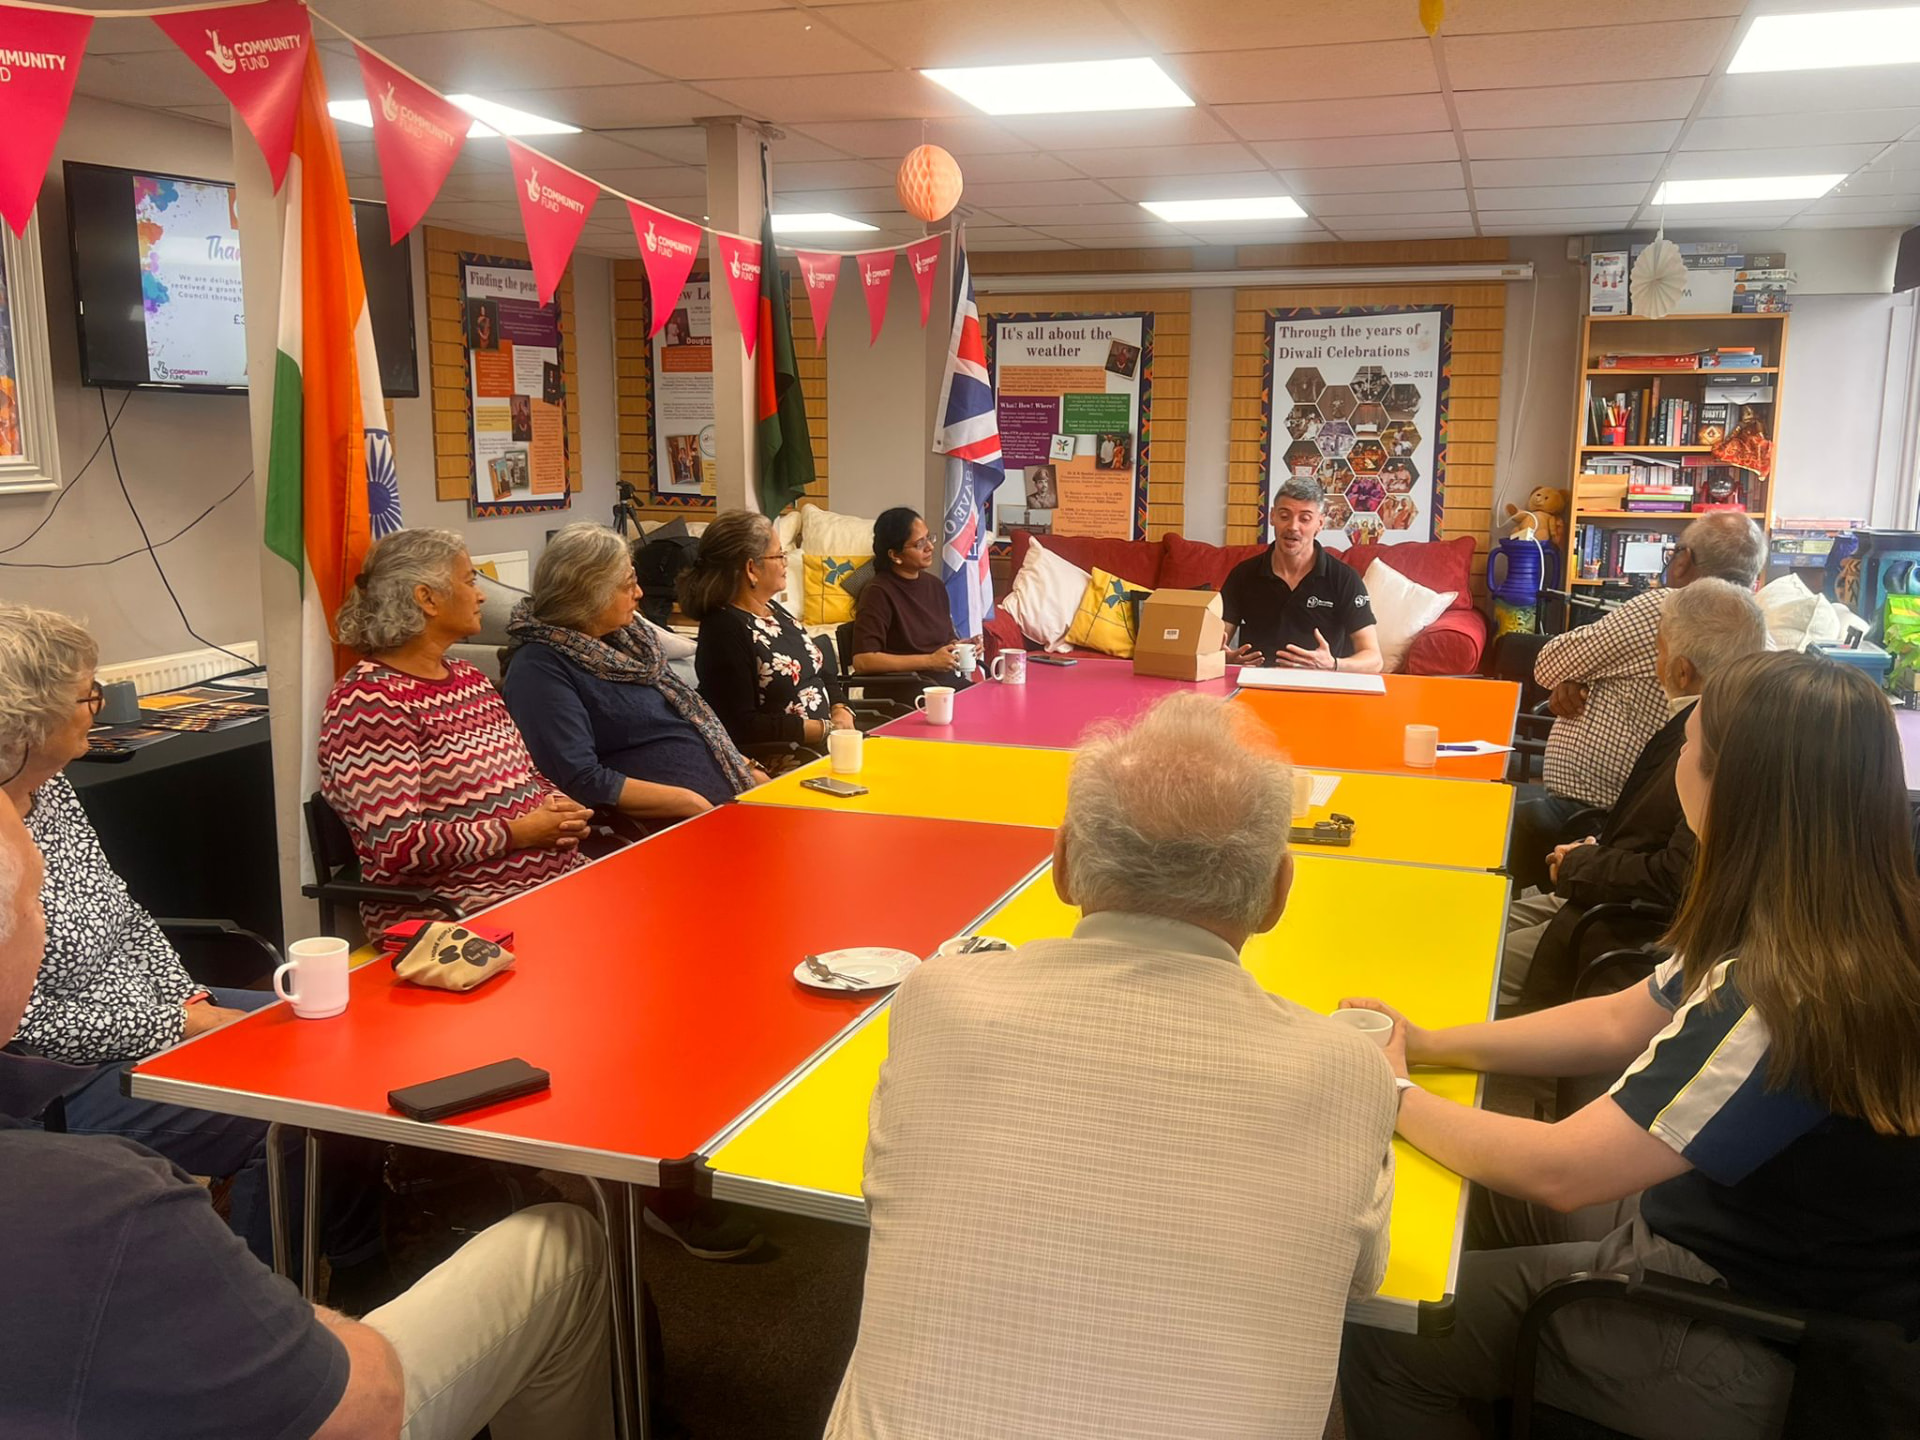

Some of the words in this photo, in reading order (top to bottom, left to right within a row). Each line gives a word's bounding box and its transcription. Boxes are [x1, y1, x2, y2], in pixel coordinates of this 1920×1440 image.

[234, 34, 300, 57] COMMUNITY
[240, 55, 270, 72] FUND
[401, 105, 455, 147] COMMUNITY
[540, 196, 560, 213] FUND
[541, 185, 585, 214] COMMUNITY
[657, 246, 673, 258] FUND
[658, 235, 692, 255] COMMUNITY
[171, 283, 205, 291] received
[470, 271, 503, 292] Finding
[505, 275, 518, 290] the
[178, 291, 209, 299] Council
[211, 294, 242, 303] through
[1002, 326, 1023, 340] It's
[1027, 327, 1044, 340] all
[1048, 326, 1086, 340] about
[1090, 326, 1112, 340] the
[1279, 325, 1336, 340] Through
[1341, 325, 1361, 337] the
[1366, 326, 1402, 340] years
[1406, 323, 1421, 336] of
[686, 336, 711, 346] Dougla
[1026, 343, 1081, 357] weather
[1279, 346, 1322, 359] Diwali
[1327, 345, 1410, 359] Celebrations
[169, 368, 208, 376] COMMUNITY
